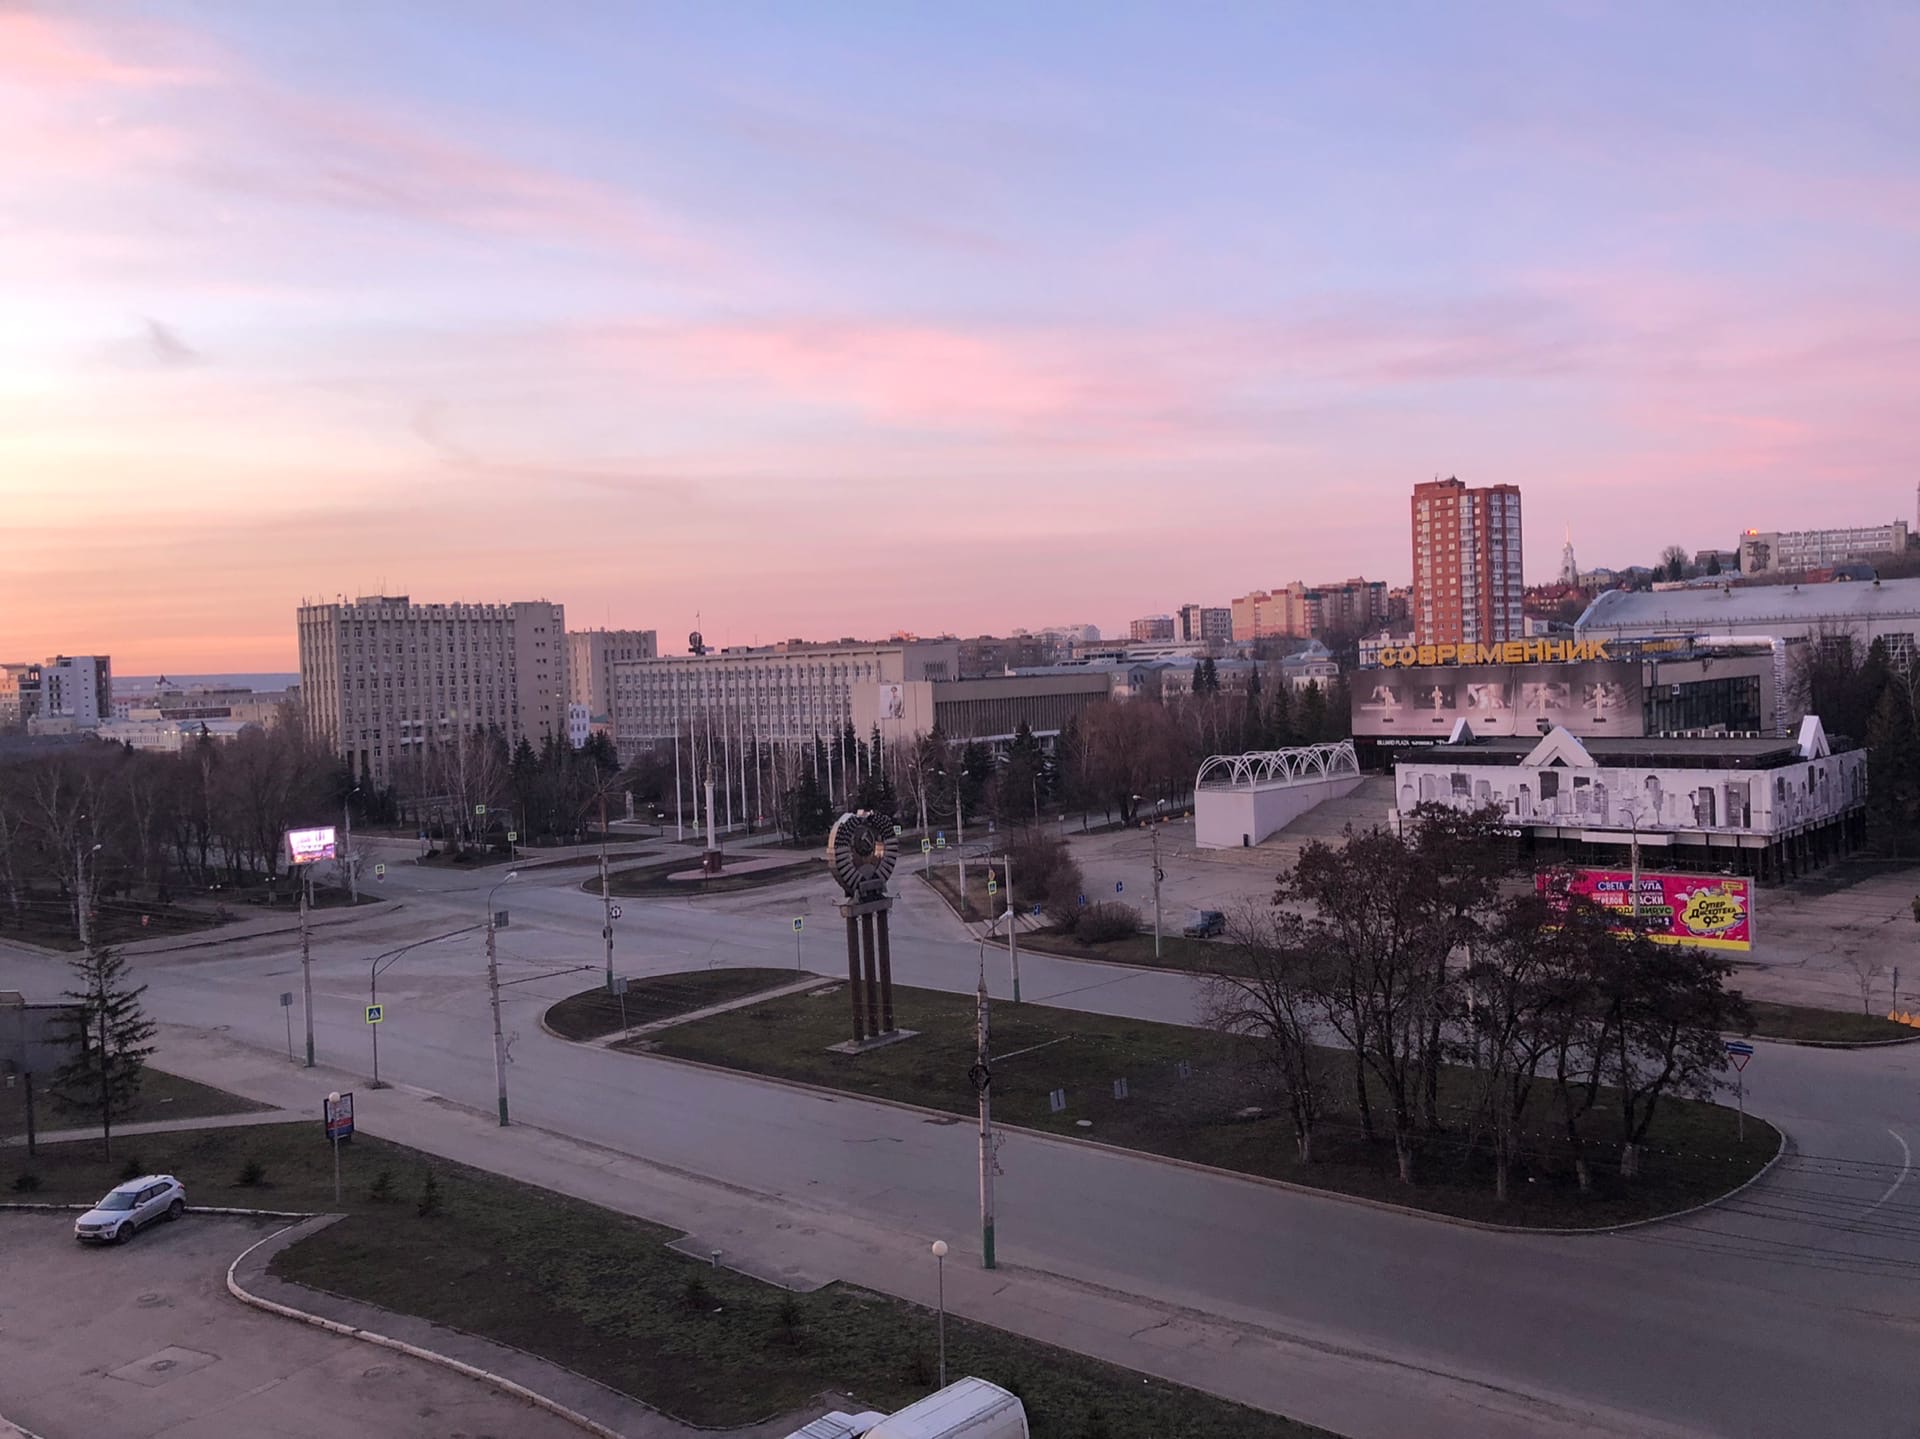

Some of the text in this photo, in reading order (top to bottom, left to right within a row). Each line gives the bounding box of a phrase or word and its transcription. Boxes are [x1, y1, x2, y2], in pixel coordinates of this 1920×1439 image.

[1380, 639, 1611, 667] СОВРЕМЕННИК
[1597, 881, 1625, 891] СВЕТА
[1628, 895, 1664, 905] КАСКИ
[1639, 906, 1673, 915] ВИРУС
